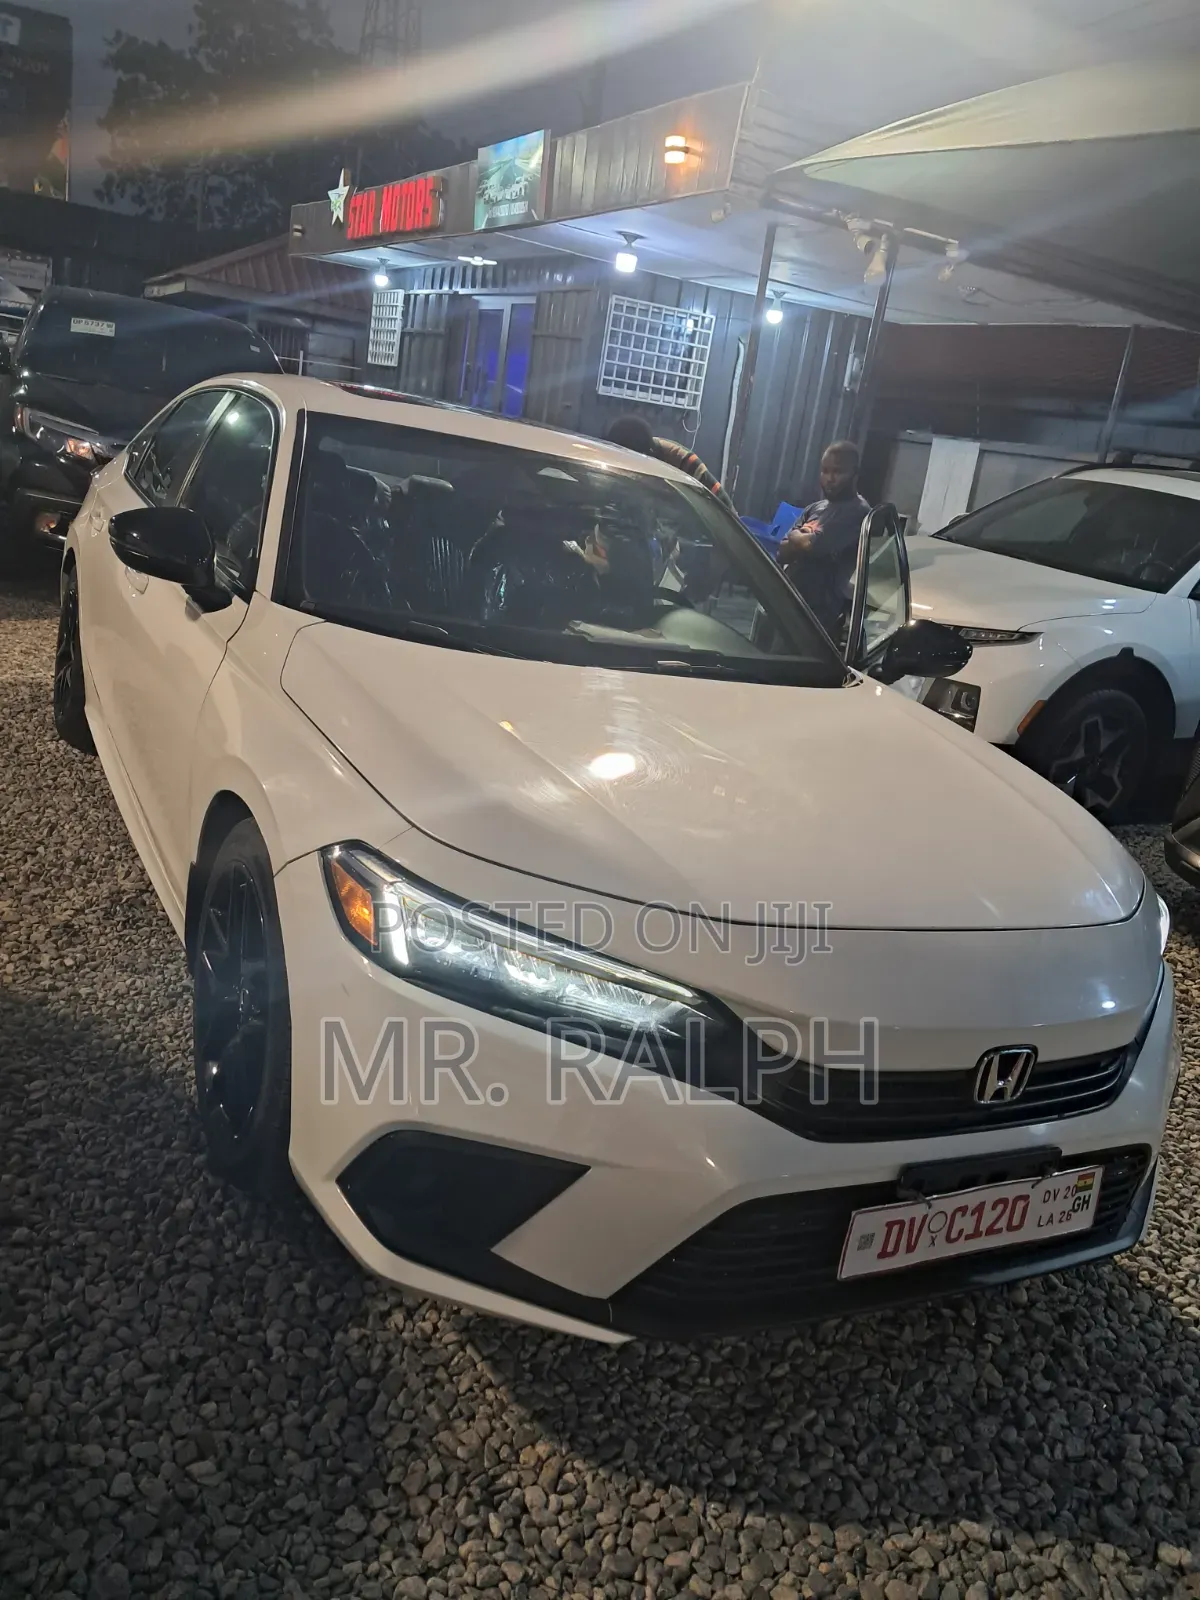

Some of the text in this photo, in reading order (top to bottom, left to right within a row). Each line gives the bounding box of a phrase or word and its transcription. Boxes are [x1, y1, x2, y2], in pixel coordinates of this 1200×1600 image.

[347, 176, 434, 240] STAR MOTORS
[1043, 1184, 1078, 1204] DV 20
[1071, 1193, 1092, 1213] GH
[1037, 1212, 1054, 1228] LA
[877, 1213, 929, 1260] DV
